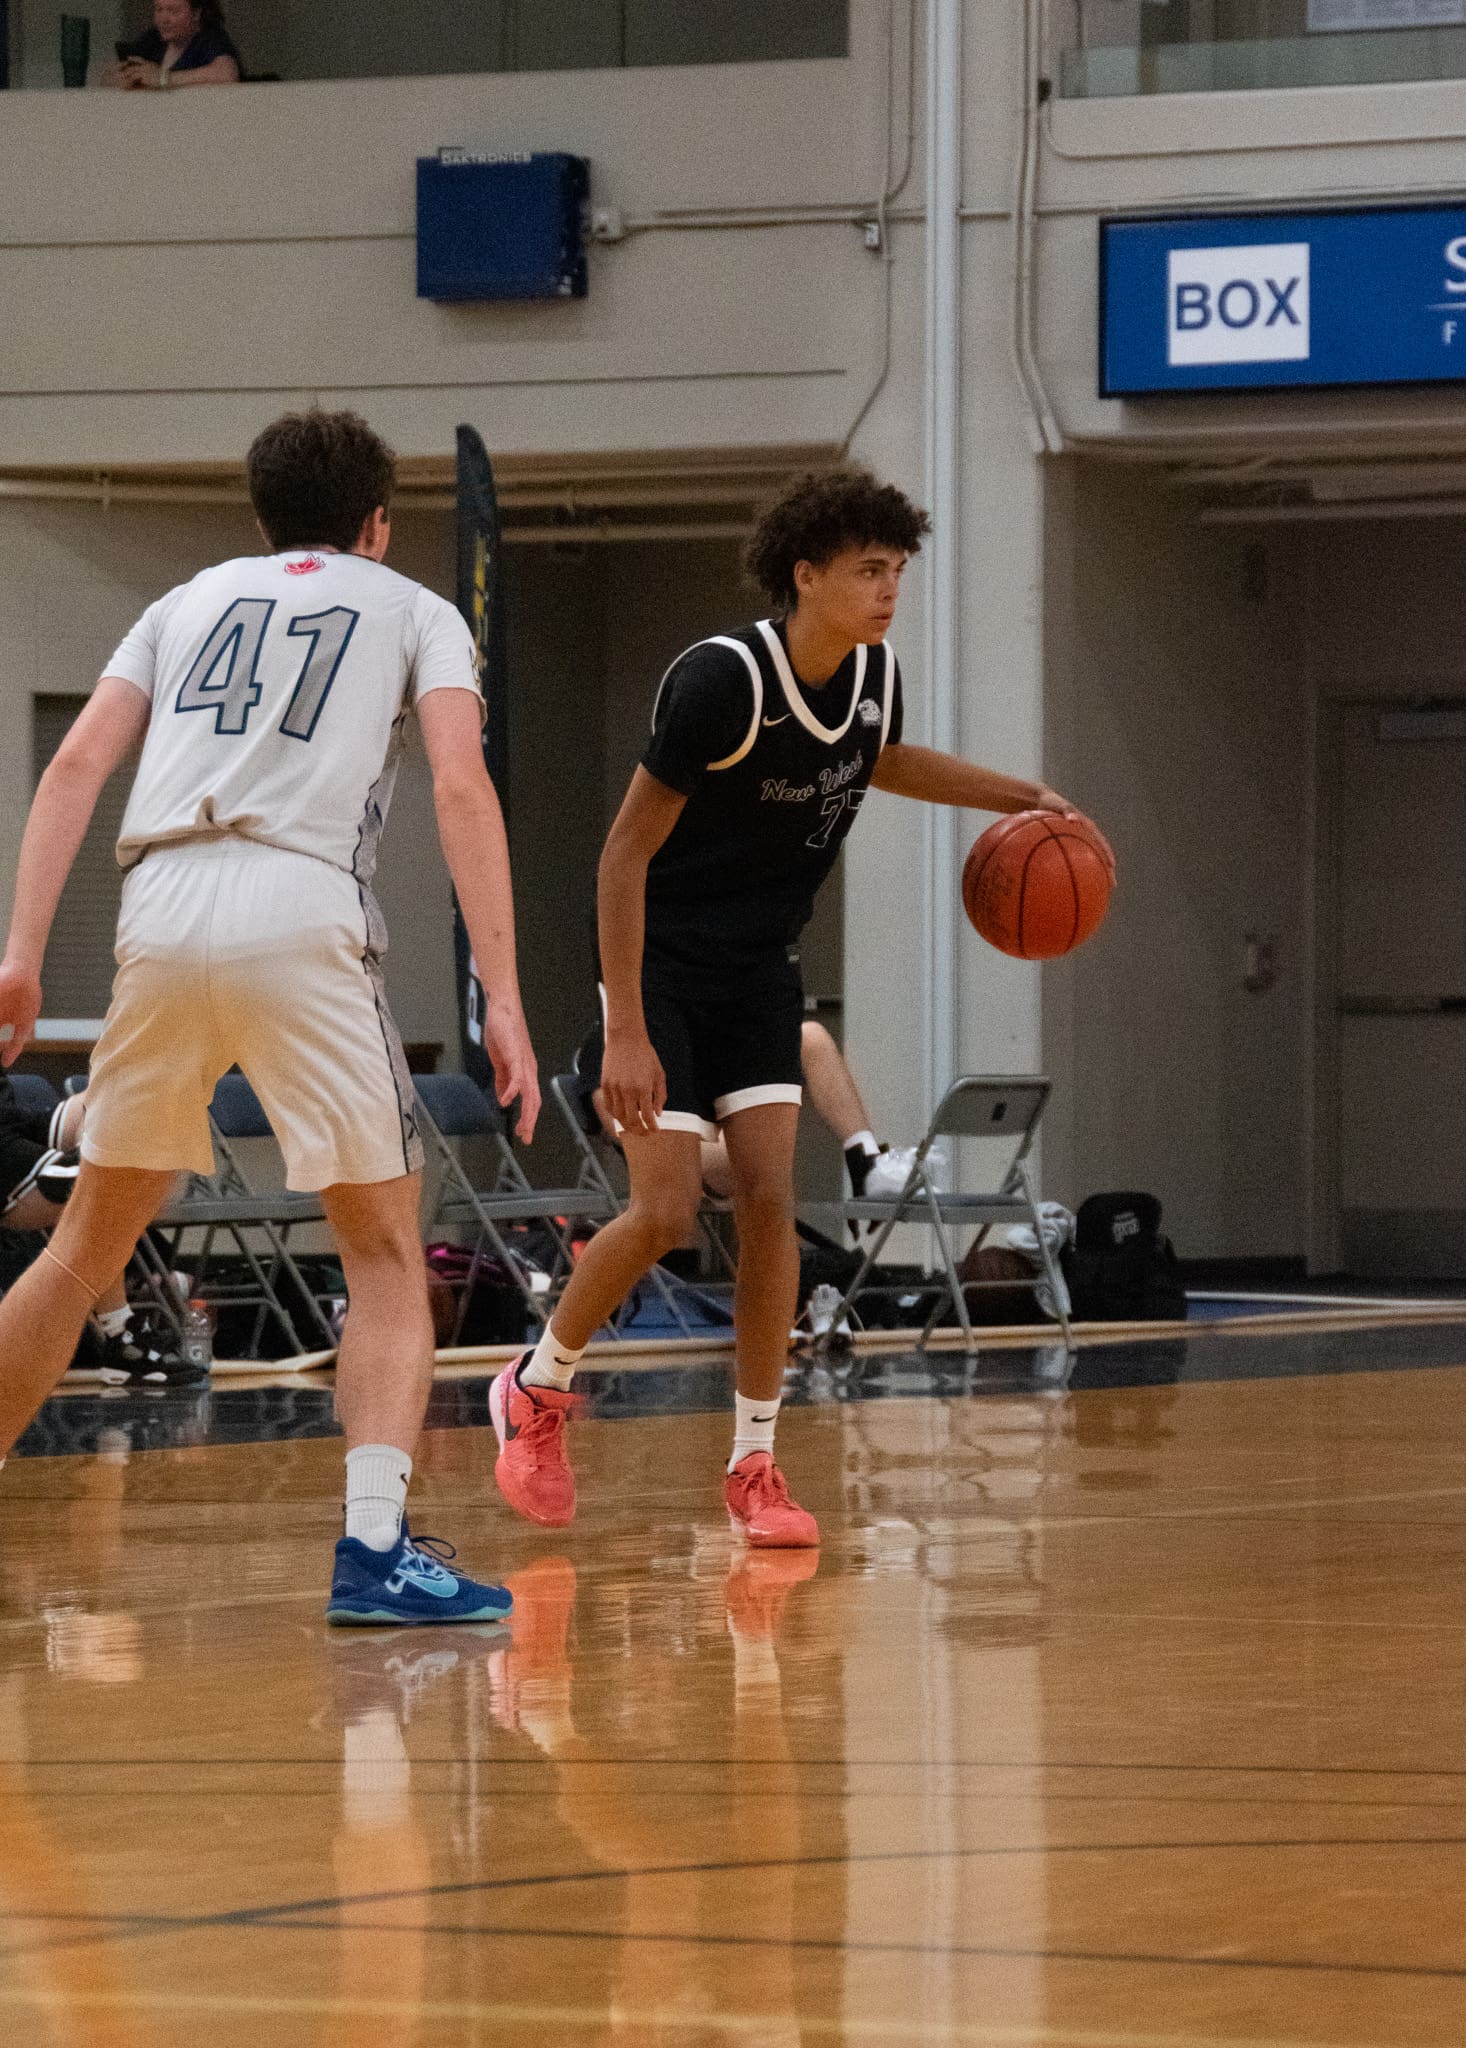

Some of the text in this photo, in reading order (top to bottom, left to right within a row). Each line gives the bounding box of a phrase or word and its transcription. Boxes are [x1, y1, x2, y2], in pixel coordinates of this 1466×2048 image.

[1175, 277, 1301, 331] BOX
[175, 597, 360, 742] 41
[760, 749, 864, 802] New West
[805, 788, 868, 848] 7
